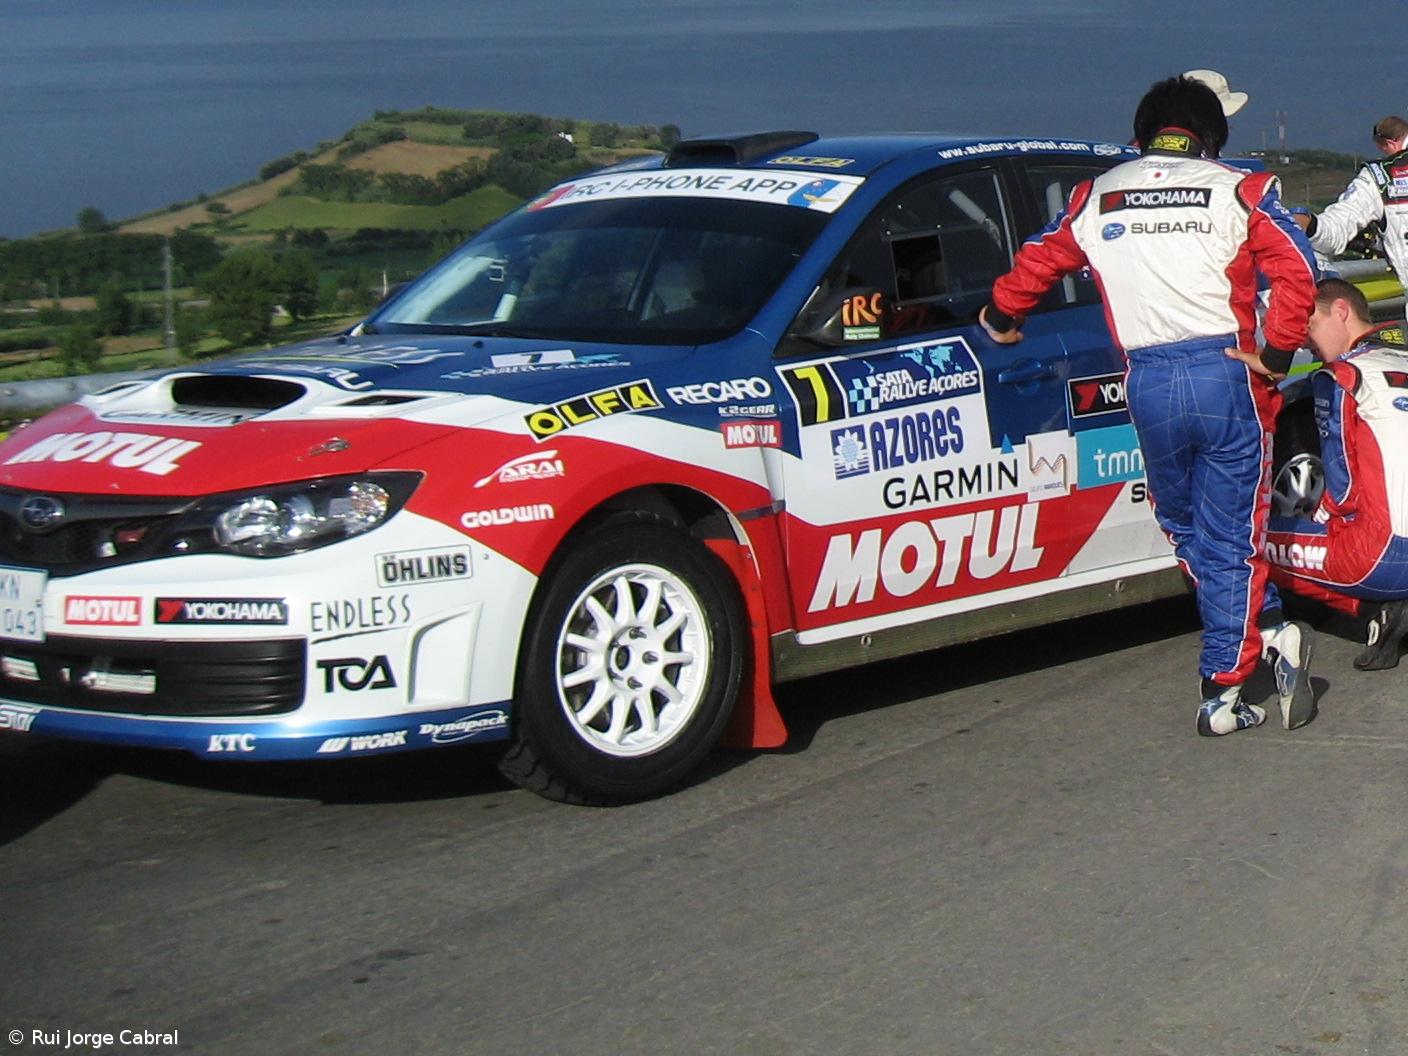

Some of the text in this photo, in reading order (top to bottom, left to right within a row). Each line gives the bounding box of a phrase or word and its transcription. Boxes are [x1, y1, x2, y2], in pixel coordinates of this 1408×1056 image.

[609, 175, 726, 194] I-PHONE
[729, 177, 799, 195] APP
[1123, 190, 1206, 207] YOKOHAMA
[1130, 221, 1213, 235] SUBARU
[521, 353, 543, 364] 7
[875, 368, 914, 388] SATA
[879, 370, 979, 404] RALLYE AÇORES
[666, 376, 772, 406] RECARO
[793, 366, 829, 423] 7
[529, 385, 656, 435] OLFA
[727, 423, 778, 445] MOTUL
[2, 431, 203, 476] MOTUL
[499, 459, 565, 479] ARAI
[882, 459, 1018, 510] GARMIN
[382, 552, 468, 583] ÖHLINS
[807, 501, 1046, 614] MOTUL
[66, 599, 140, 623] MOTUL
[185, 600, 283, 621] YOKOHAMA
[311, 593, 412, 633] ENDLESS
[419, 715, 509, 739] Dynapack
[207, 733, 257, 753] KTC
[351, 730, 408, 751] WORK
